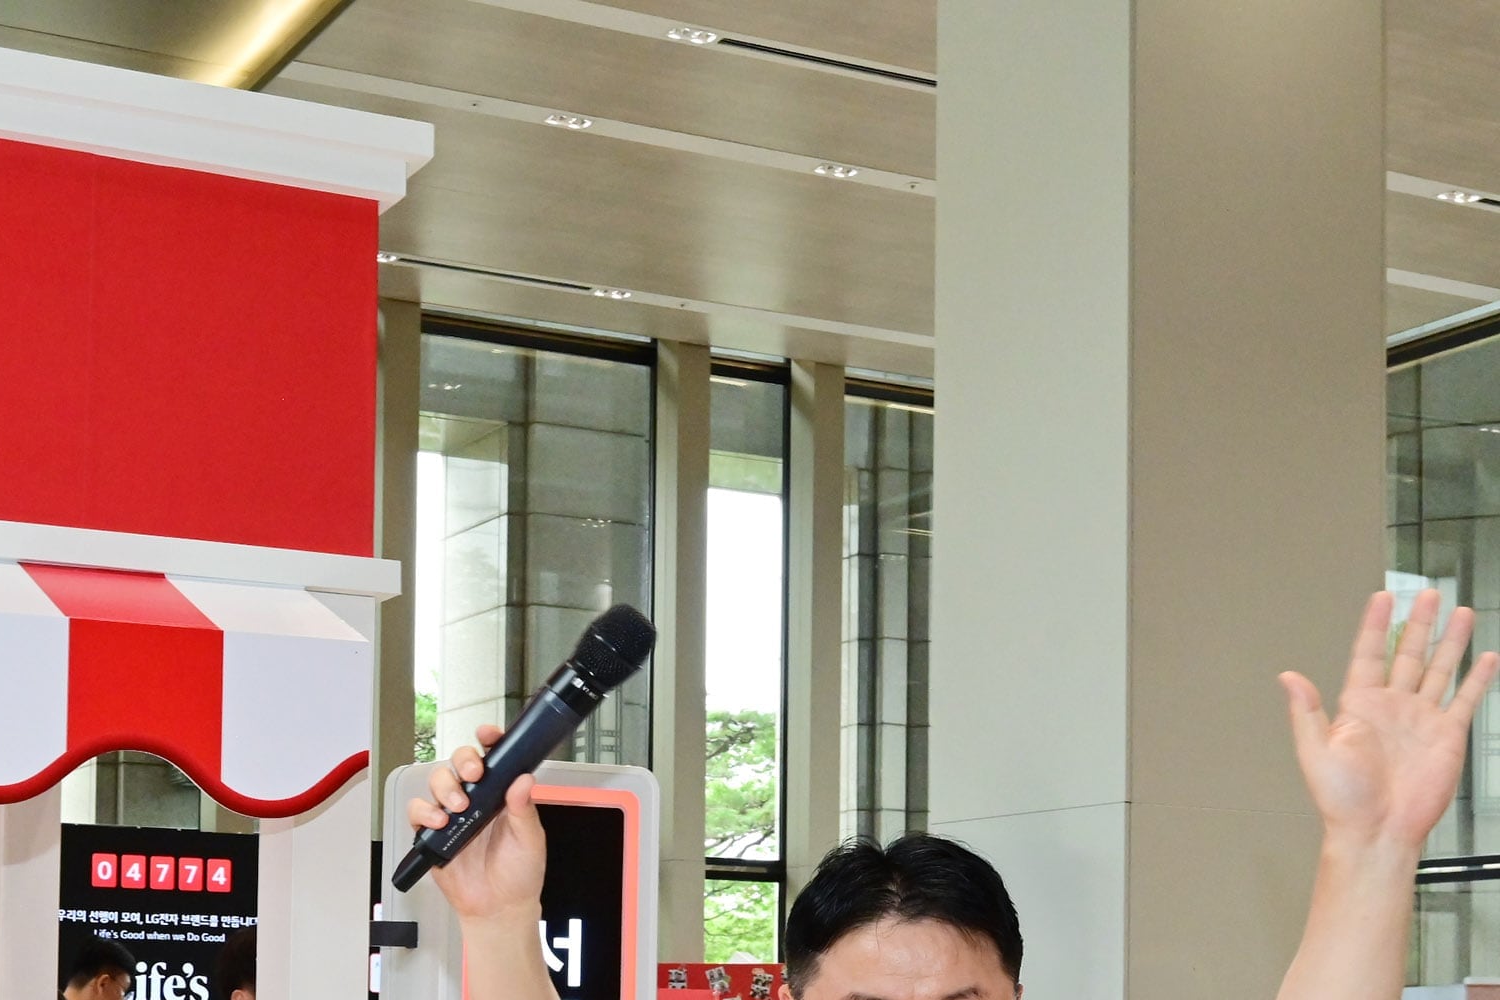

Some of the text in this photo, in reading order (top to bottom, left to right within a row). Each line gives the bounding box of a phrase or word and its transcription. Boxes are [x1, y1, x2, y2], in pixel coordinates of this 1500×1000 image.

[97, 861, 227, 885] 04774
[145, 913, 179, 926] LG전자
[180, 914, 218, 927] 브랜드를
[120, 930, 145, 939] Good
[146, 931, 170, 940] when
[186, 932, 200, 941] Do
[201, 932, 226, 942] Good
